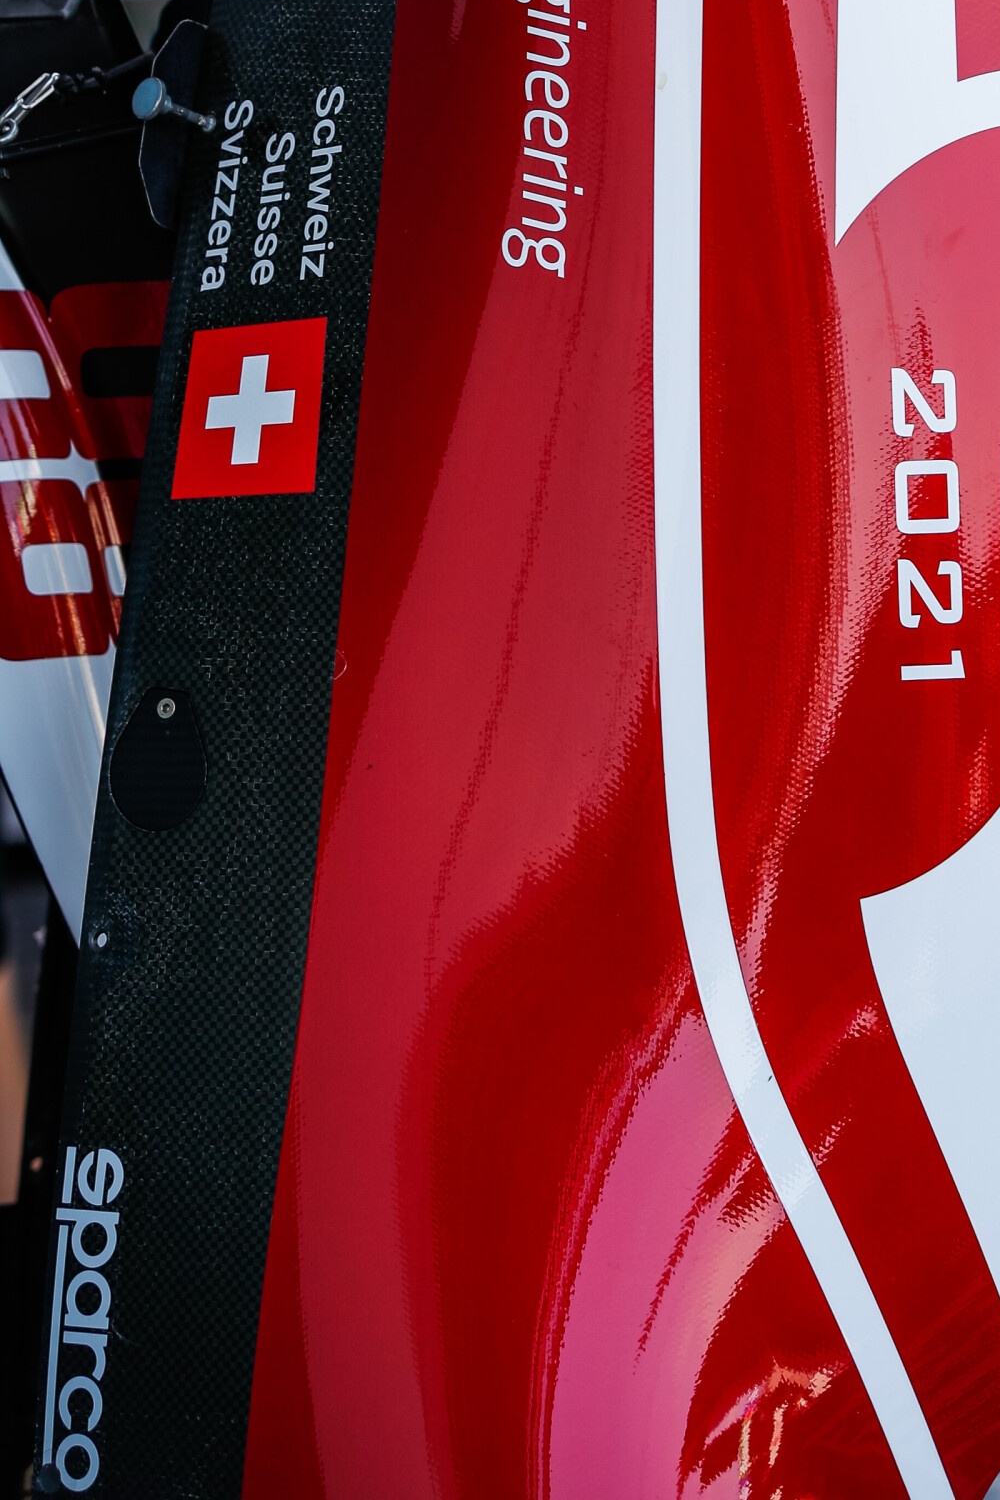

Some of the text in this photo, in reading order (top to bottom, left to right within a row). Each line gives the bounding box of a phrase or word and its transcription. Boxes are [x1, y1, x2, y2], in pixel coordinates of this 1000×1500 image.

[200, 99, 254, 292] Svizzera
[250, 132, 296, 285] Suisse
[300, 86, 345, 280] Schweiz
[890, 366, 966, 681] 2021
[55, 1148, 124, 1492] sparco
